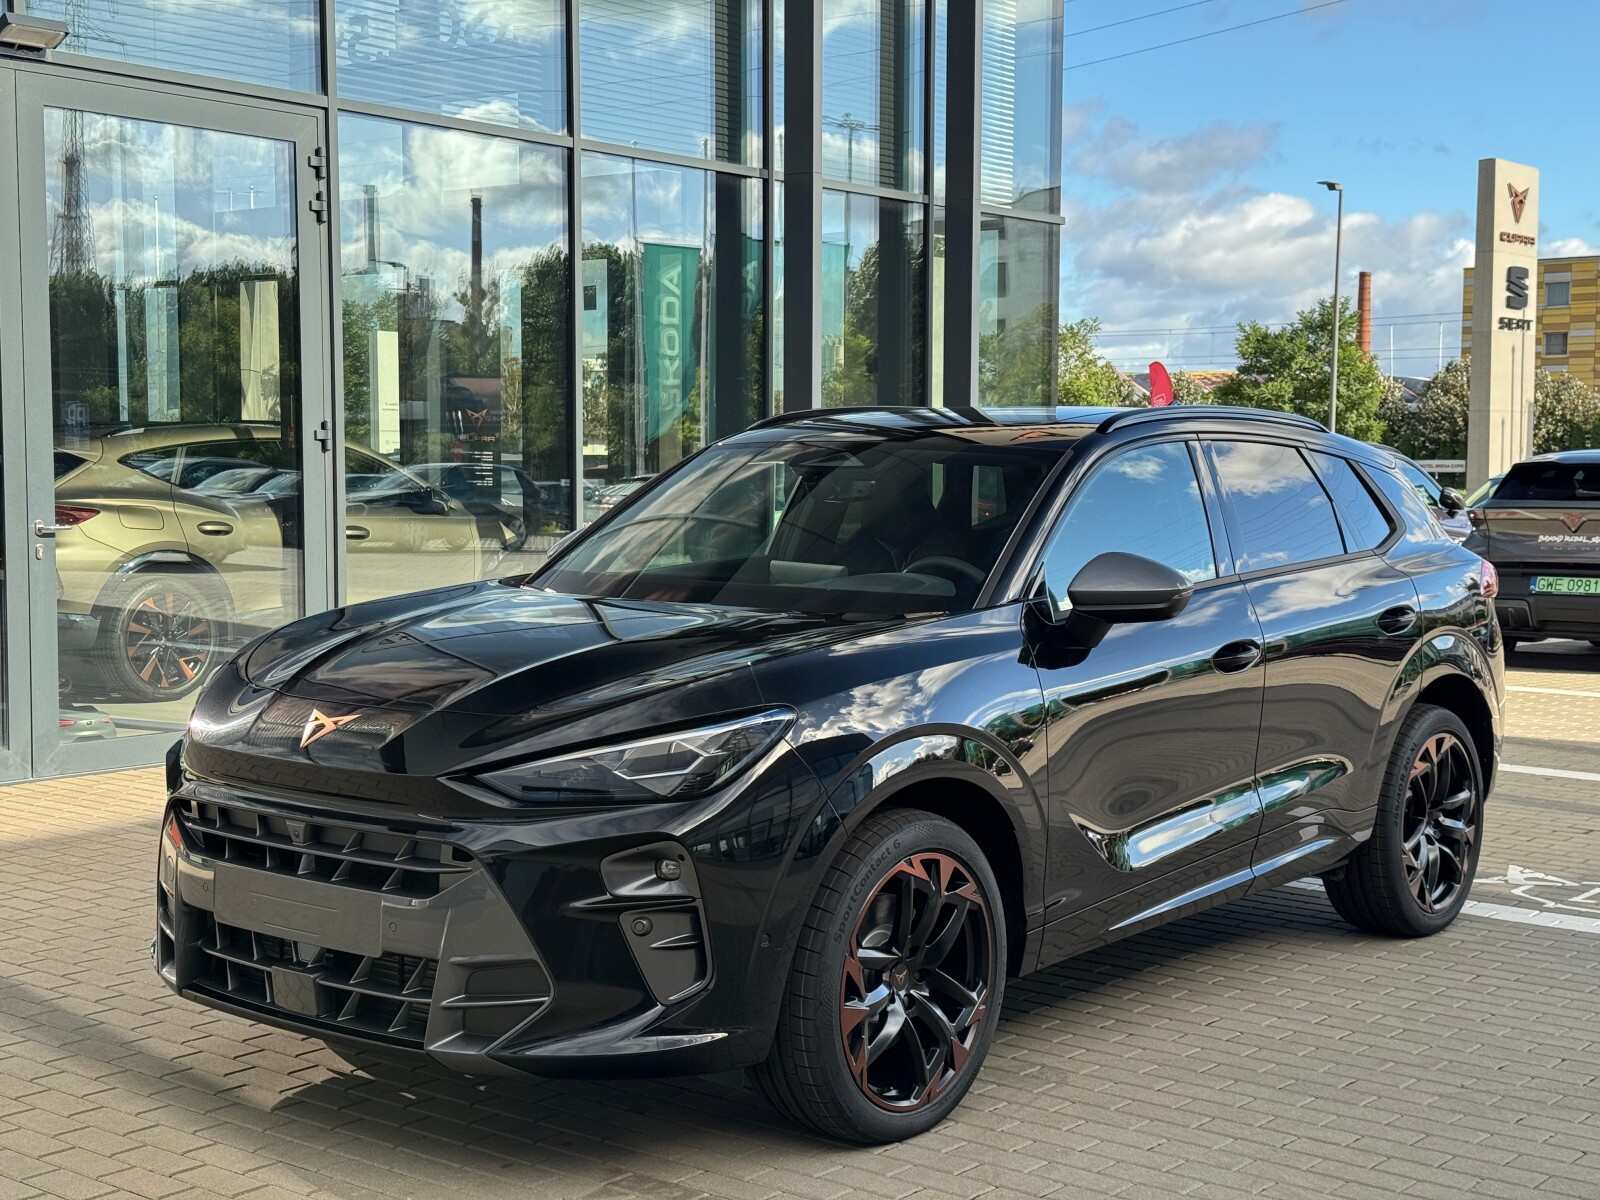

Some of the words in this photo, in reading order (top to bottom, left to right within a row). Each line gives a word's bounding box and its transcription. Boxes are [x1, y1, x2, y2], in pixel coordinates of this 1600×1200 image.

[1498, 316, 1534, 332] SEAT
[1537, 577, 1564, 591] GWE
[1567, 578, 1599, 592] 0981
[1403, 757, 1411, 773] 20
[1409, 742, 1419, 754] XL
[834, 847, 892, 943] SportContact
[893, 838, 901, 850] 6
